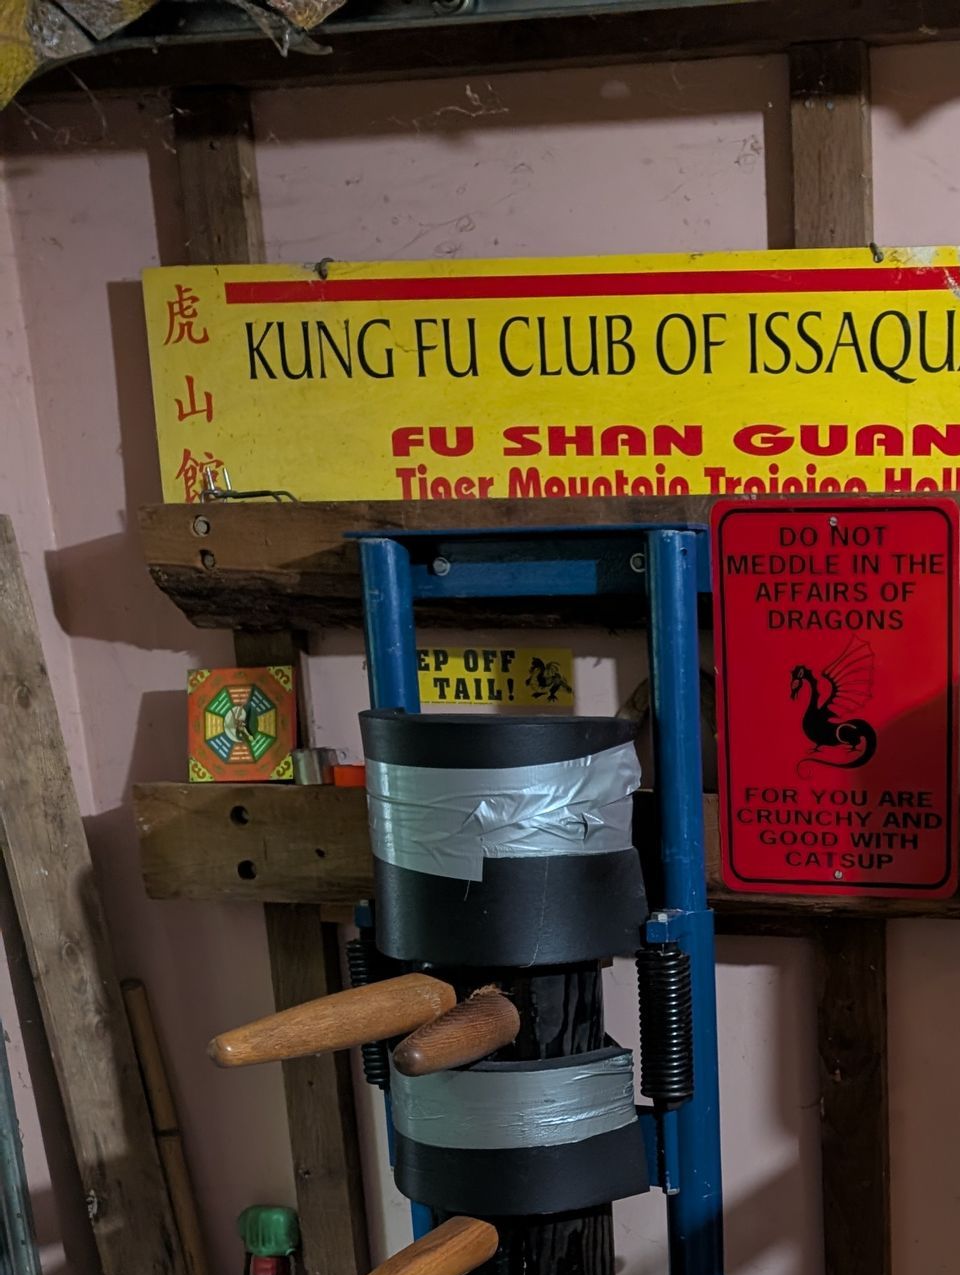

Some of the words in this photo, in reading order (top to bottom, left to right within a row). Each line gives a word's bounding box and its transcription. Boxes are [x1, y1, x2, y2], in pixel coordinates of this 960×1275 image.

[245, 318, 394, 381] KUNG
[415, 317, 478, 378] FU
[499, 315, 636, 378] CLUB
[656, 312, 727, 375] OF
[391, 426, 474, 457] FU
[503, 424, 703, 457] SHAN
[395, 464, 494, 500] Tiger
[508, 462, 690, 499] Mountain
[779, 526, 818, 547] DO
[831, 525, 888, 547] NOT
[726, 554, 838, 576] MEDDLE
[853, 554, 880, 575] IN
[890, 553, 945, 576] THE
[755, 581, 869, 603] AFFAIRS
[880, 581, 917, 602] OF
[767, 609, 904, 631] DRAGONS
[464, 650, 516, 673] OFF
[433, 677, 514, 701] TAIL!
[745, 787, 798, 805] FOR
[812, 789, 869, 808] YOU
[878, 790, 934, 808] ARE
[736, 809, 872, 829] CRUNCHY
[882, 811, 943, 830] AND
[759, 830, 838, 847] GOOD
[851, 831, 919, 850] WITH
[784, 851, 894, 870] CATSUP
